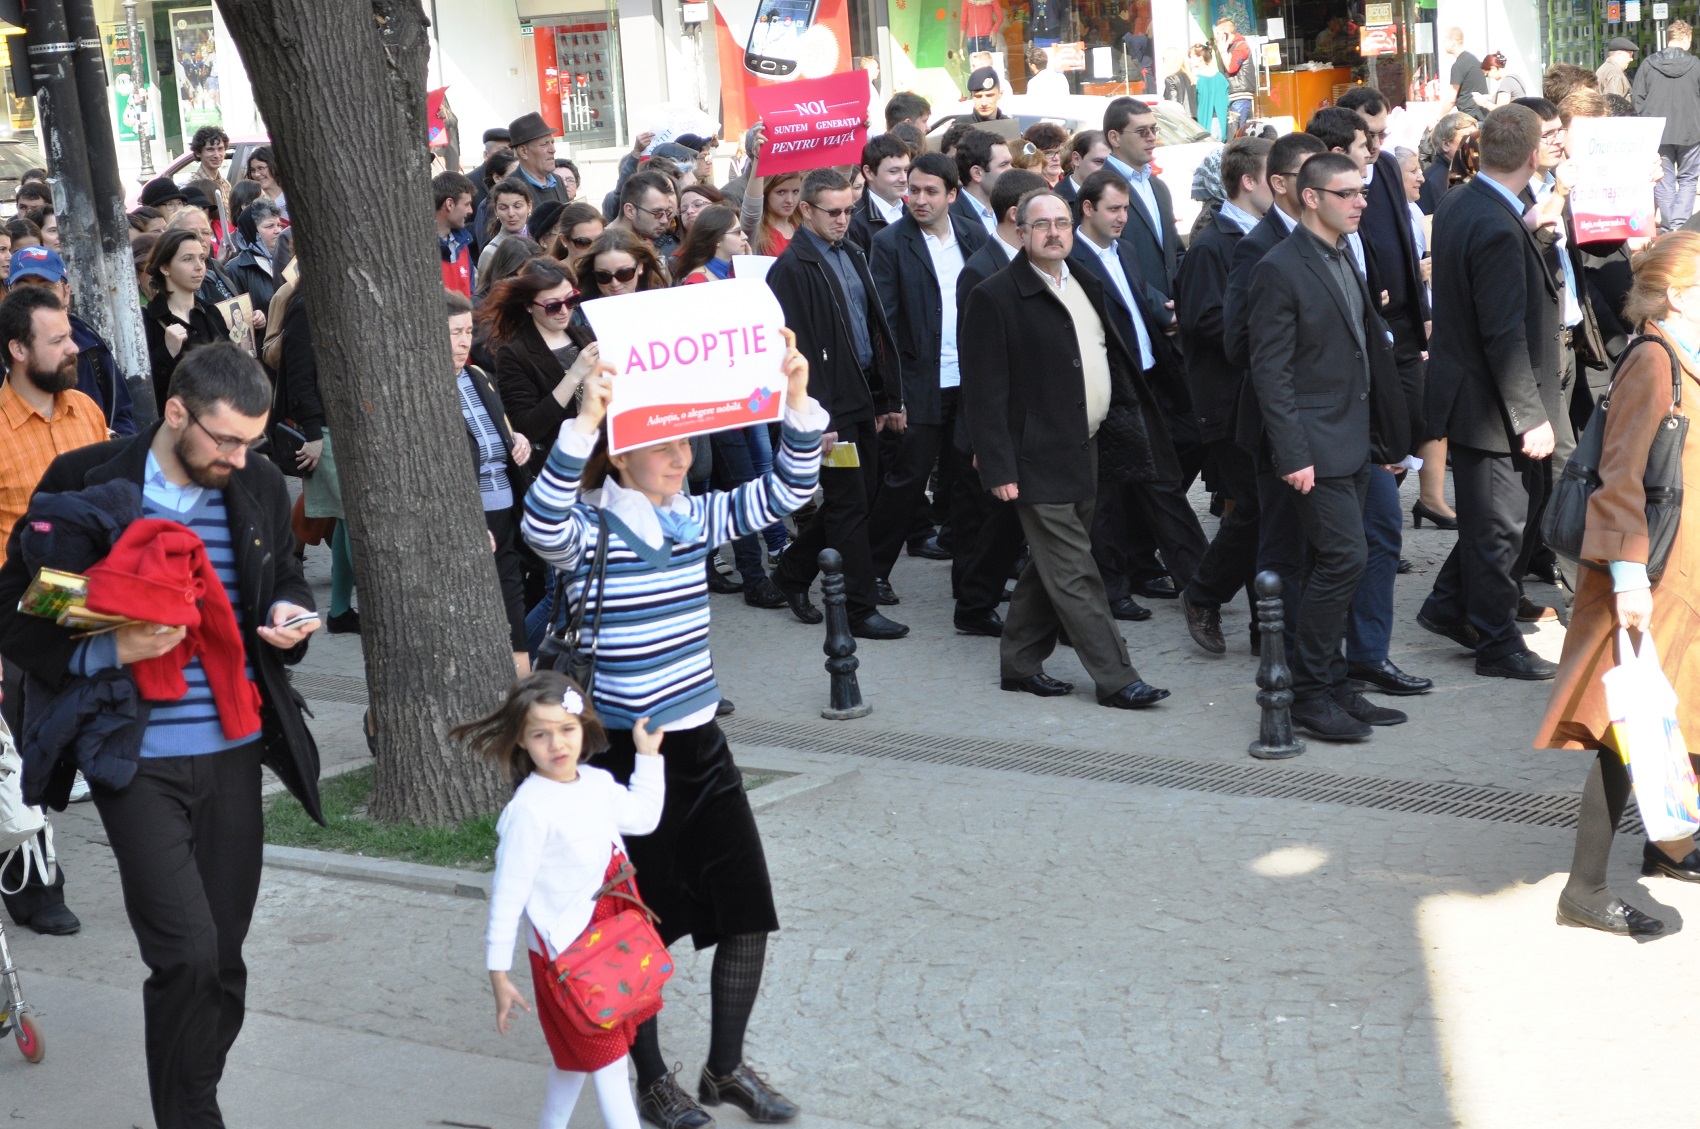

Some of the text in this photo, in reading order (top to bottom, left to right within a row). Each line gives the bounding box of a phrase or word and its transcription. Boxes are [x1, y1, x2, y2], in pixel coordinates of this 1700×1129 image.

[794, 99, 829, 116] NOI
[774, 123, 809, 135] SUNTEM
[771, 137, 820, 154] PENTRU
[625, 324, 767, 374] ADOPȚIE
[687, 407, 715, 419] alegere
